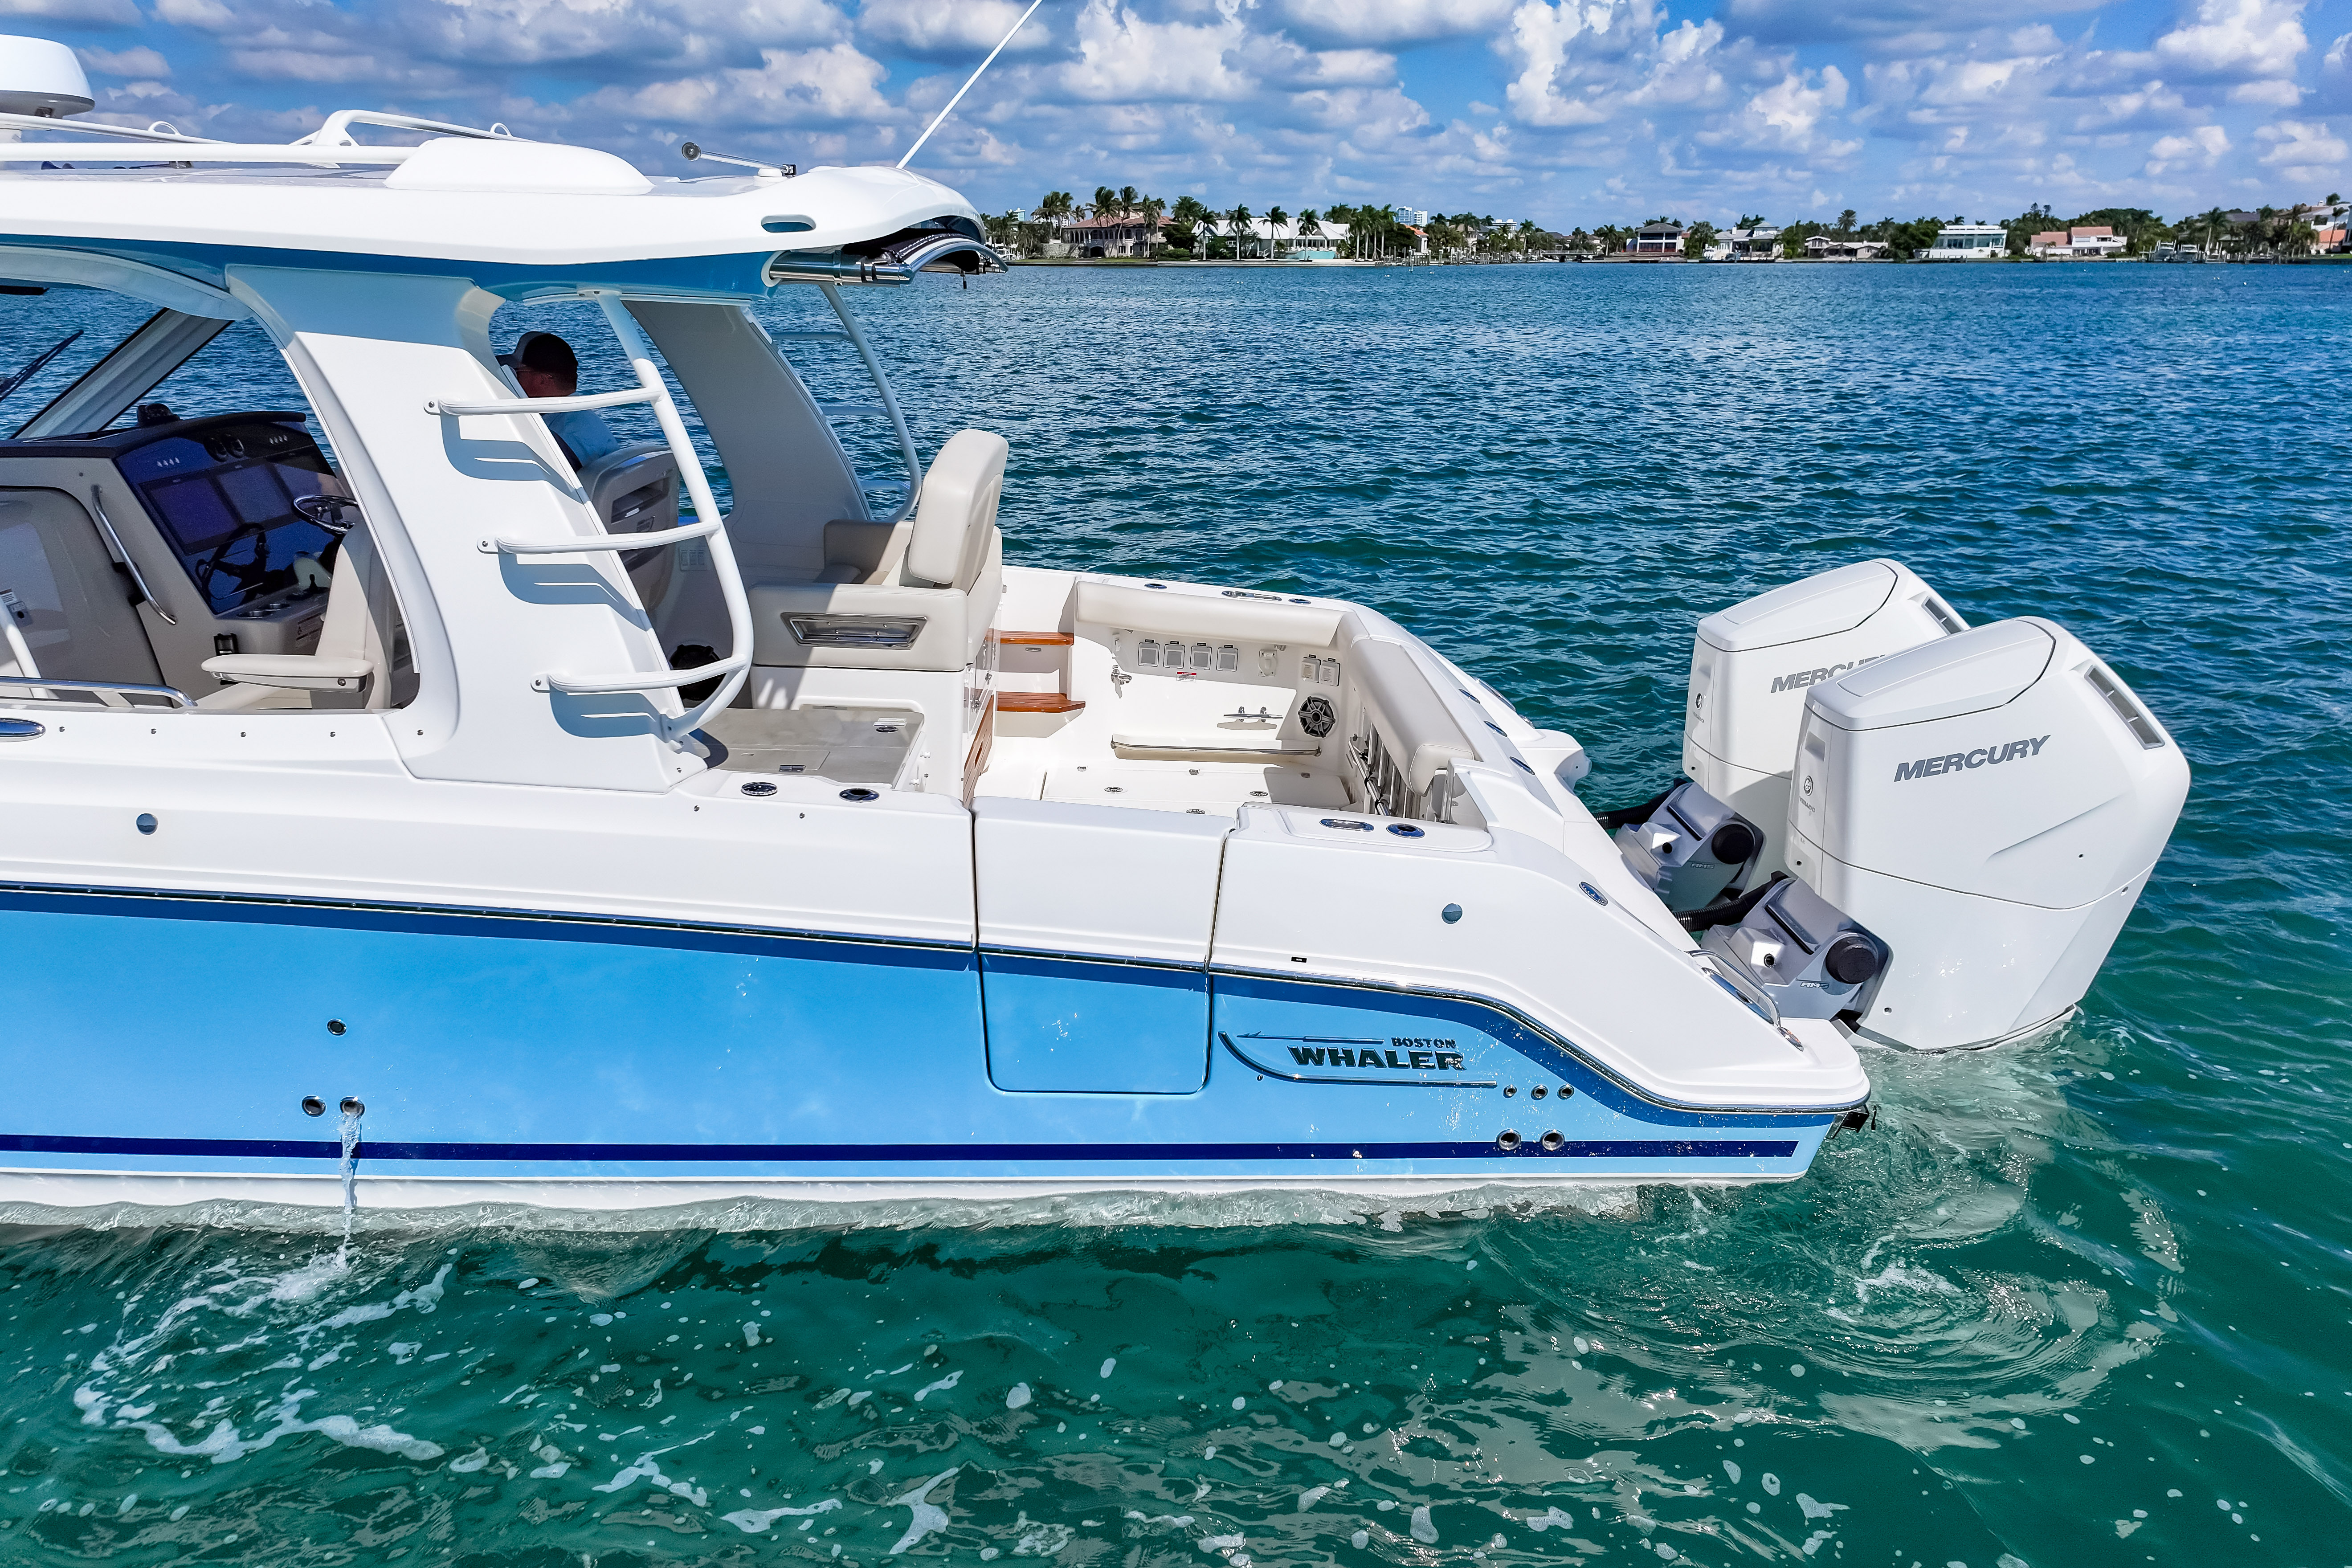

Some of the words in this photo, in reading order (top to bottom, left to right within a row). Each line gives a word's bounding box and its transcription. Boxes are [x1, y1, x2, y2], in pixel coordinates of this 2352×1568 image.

[1771, 654, 1886, 693] MERC
[1894, 735, 2051, 782] MERCURY
[1287, 1045, 1467, 1070] WHALER
[1392, 1037, 1456, 1049] BOSTON
